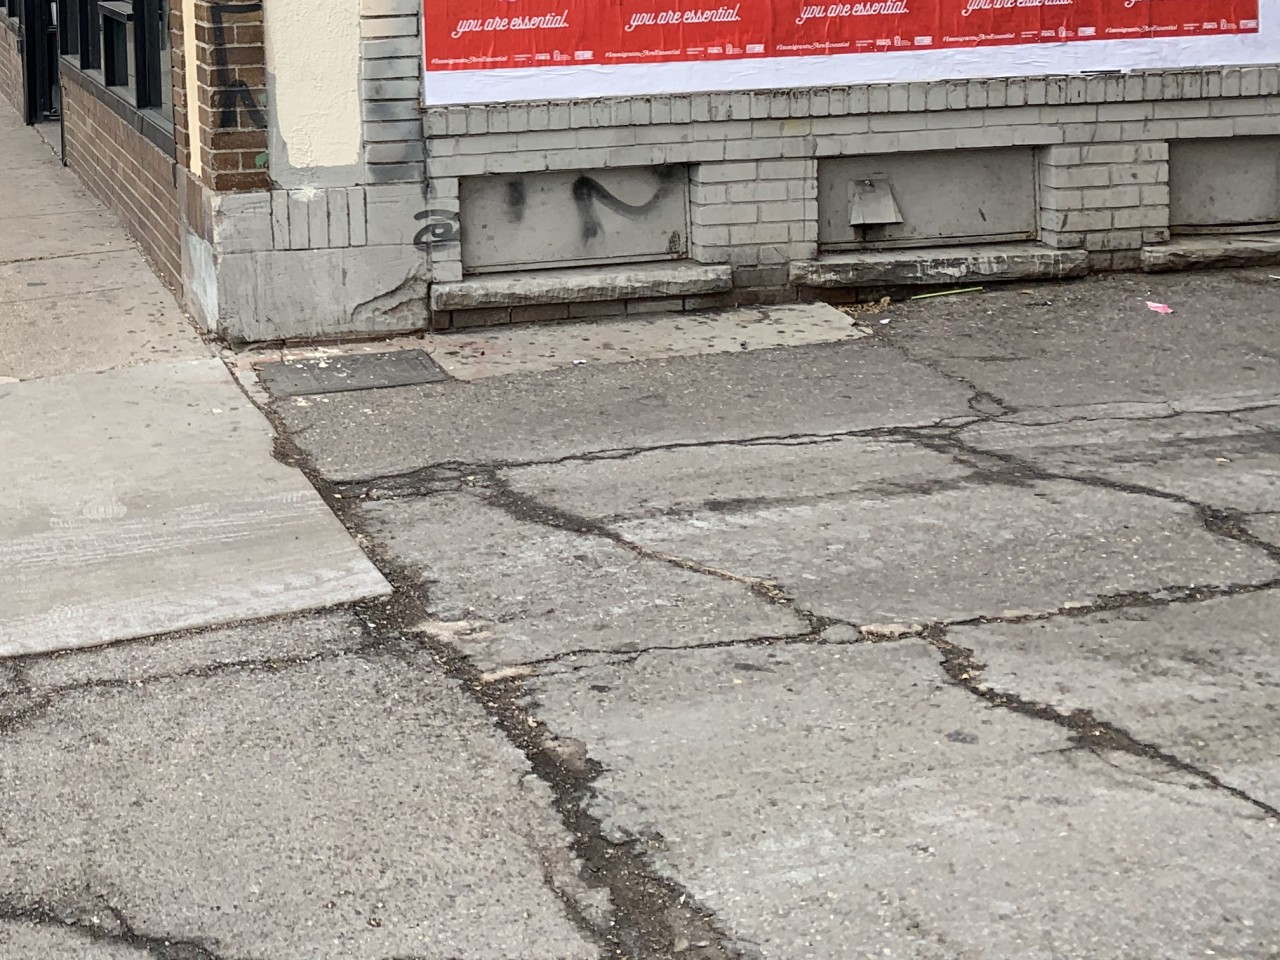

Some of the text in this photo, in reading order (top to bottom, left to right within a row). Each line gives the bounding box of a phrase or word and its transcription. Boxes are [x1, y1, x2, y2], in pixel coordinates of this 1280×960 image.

[452, 10, 569, 38] you are essential.
[625, 3, 741, 32] you are essential.
[796, 3, 825, 24] you
[828, 2, 850, 17] are
